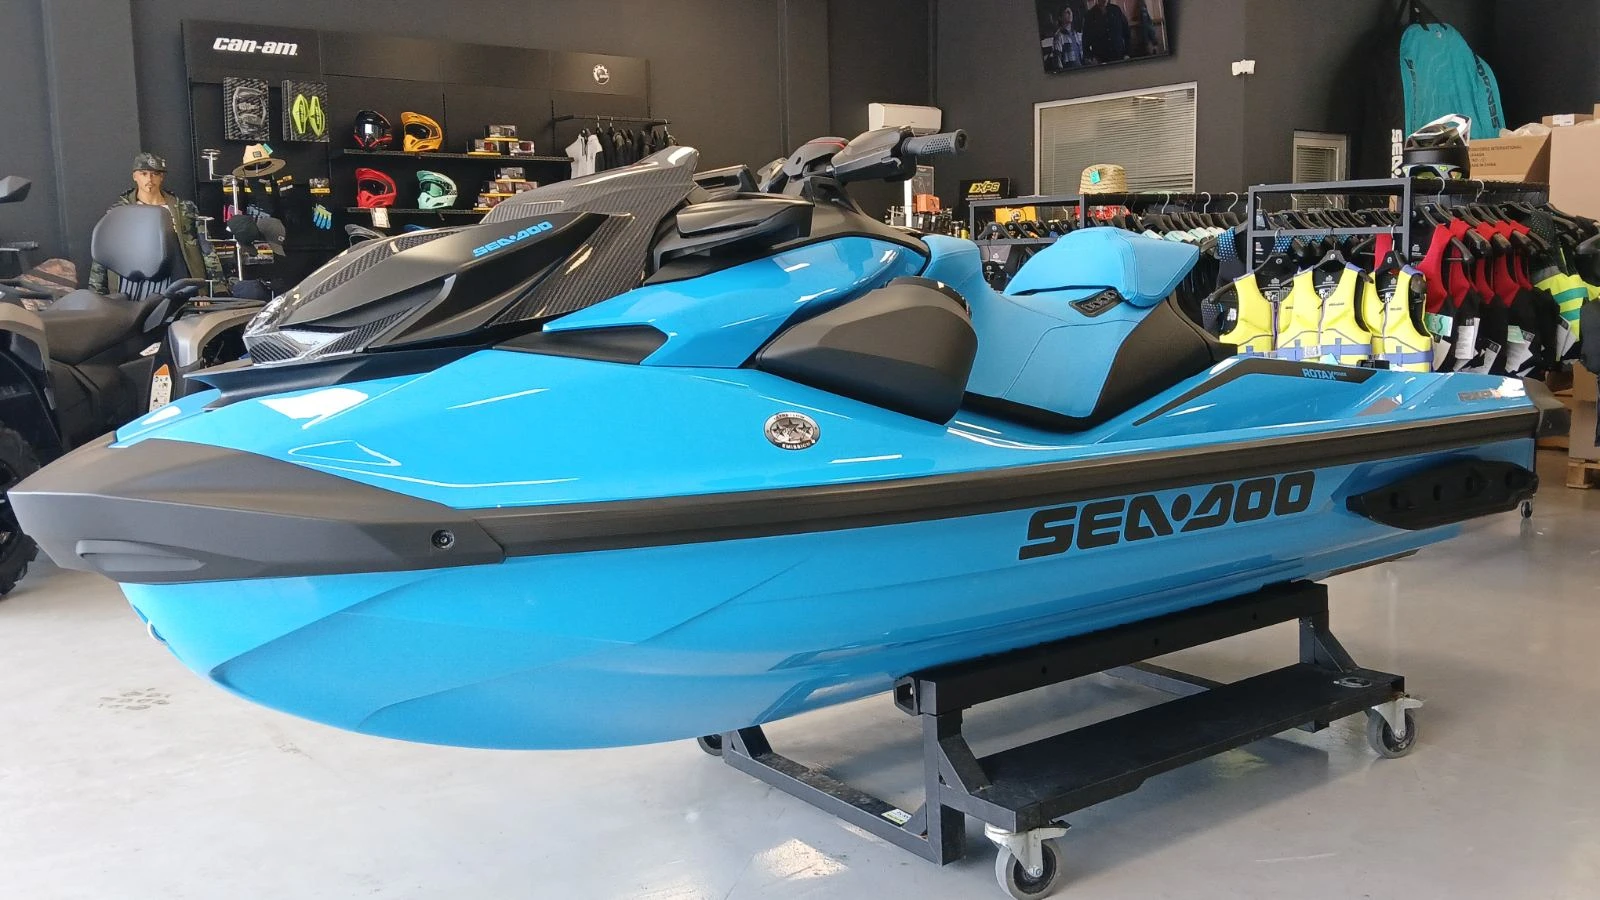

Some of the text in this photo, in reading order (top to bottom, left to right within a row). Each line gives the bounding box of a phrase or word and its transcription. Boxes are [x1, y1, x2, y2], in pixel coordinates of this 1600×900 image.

[213, 37, 298, 56] can-am
[977, 180, 1000, 193] XPS
[1302, 368, 1336, 380] ROTAX
